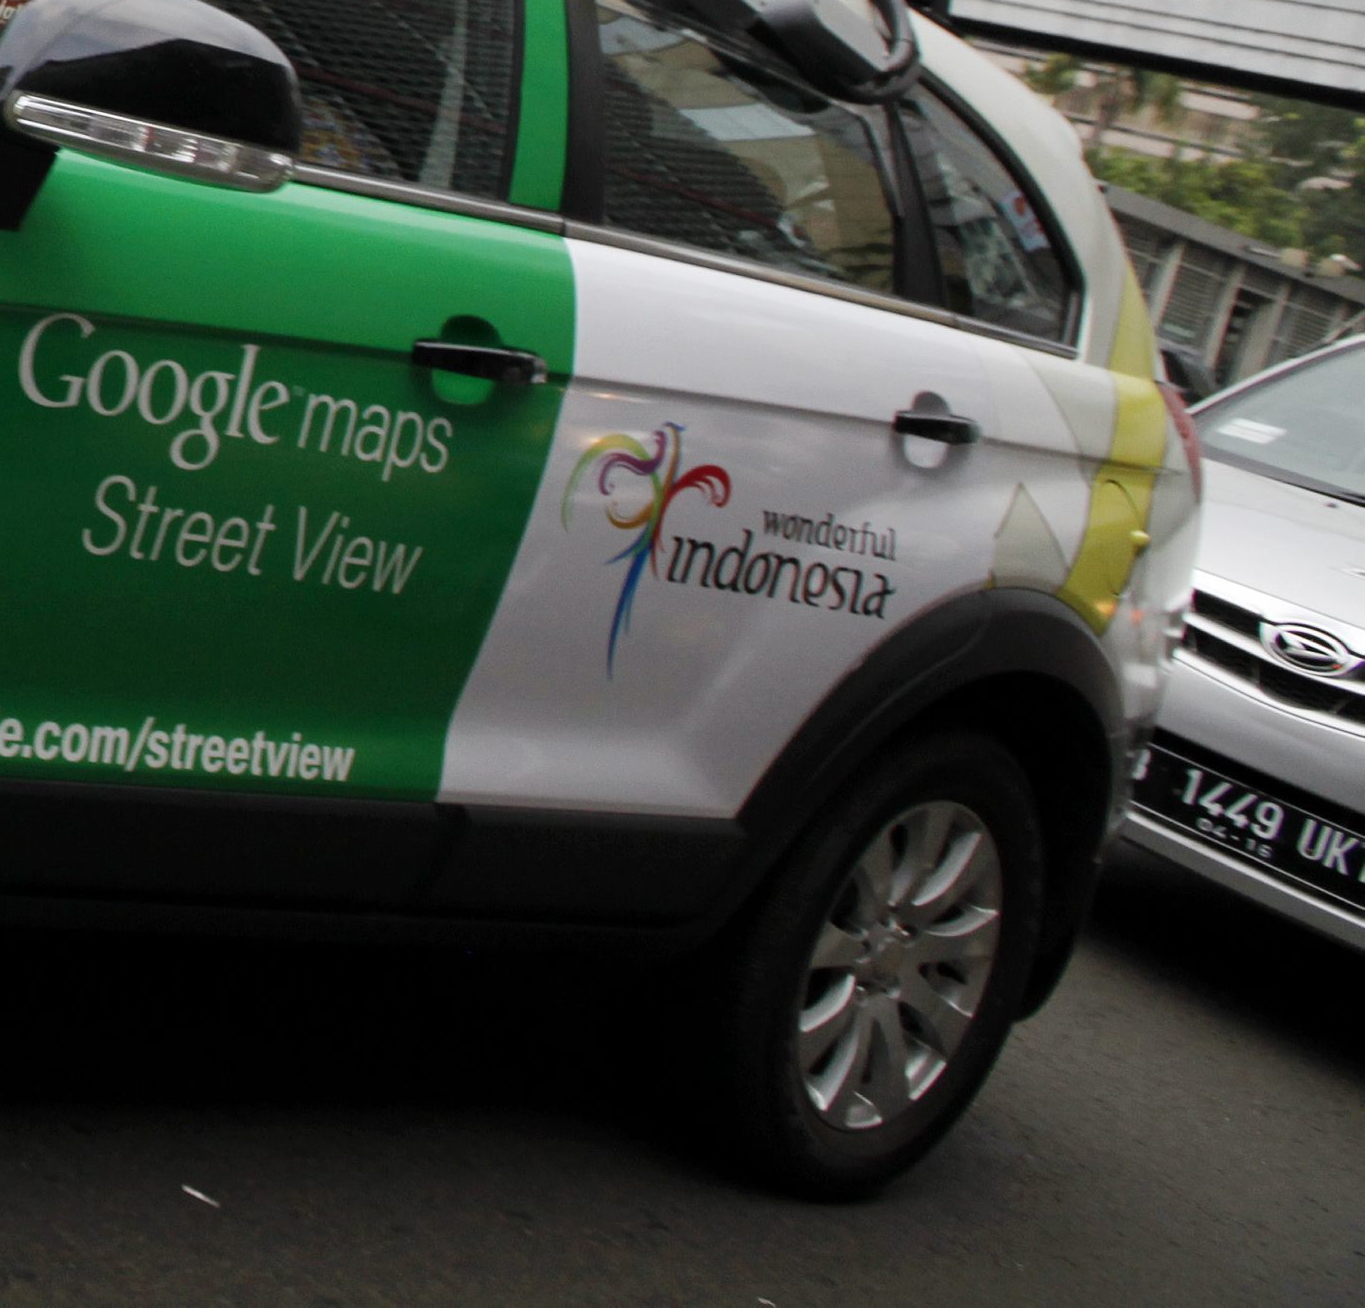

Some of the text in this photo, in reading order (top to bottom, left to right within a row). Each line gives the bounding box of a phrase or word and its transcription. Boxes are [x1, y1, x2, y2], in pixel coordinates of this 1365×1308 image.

[18, 312, 454, 483] Google maps
[81, 474, 423, 594] Street View
[666, 528, 898, 620] indonesia
[762, 509, 897, 562] wonderful
[1181, 768, 1285, 841] 1449
